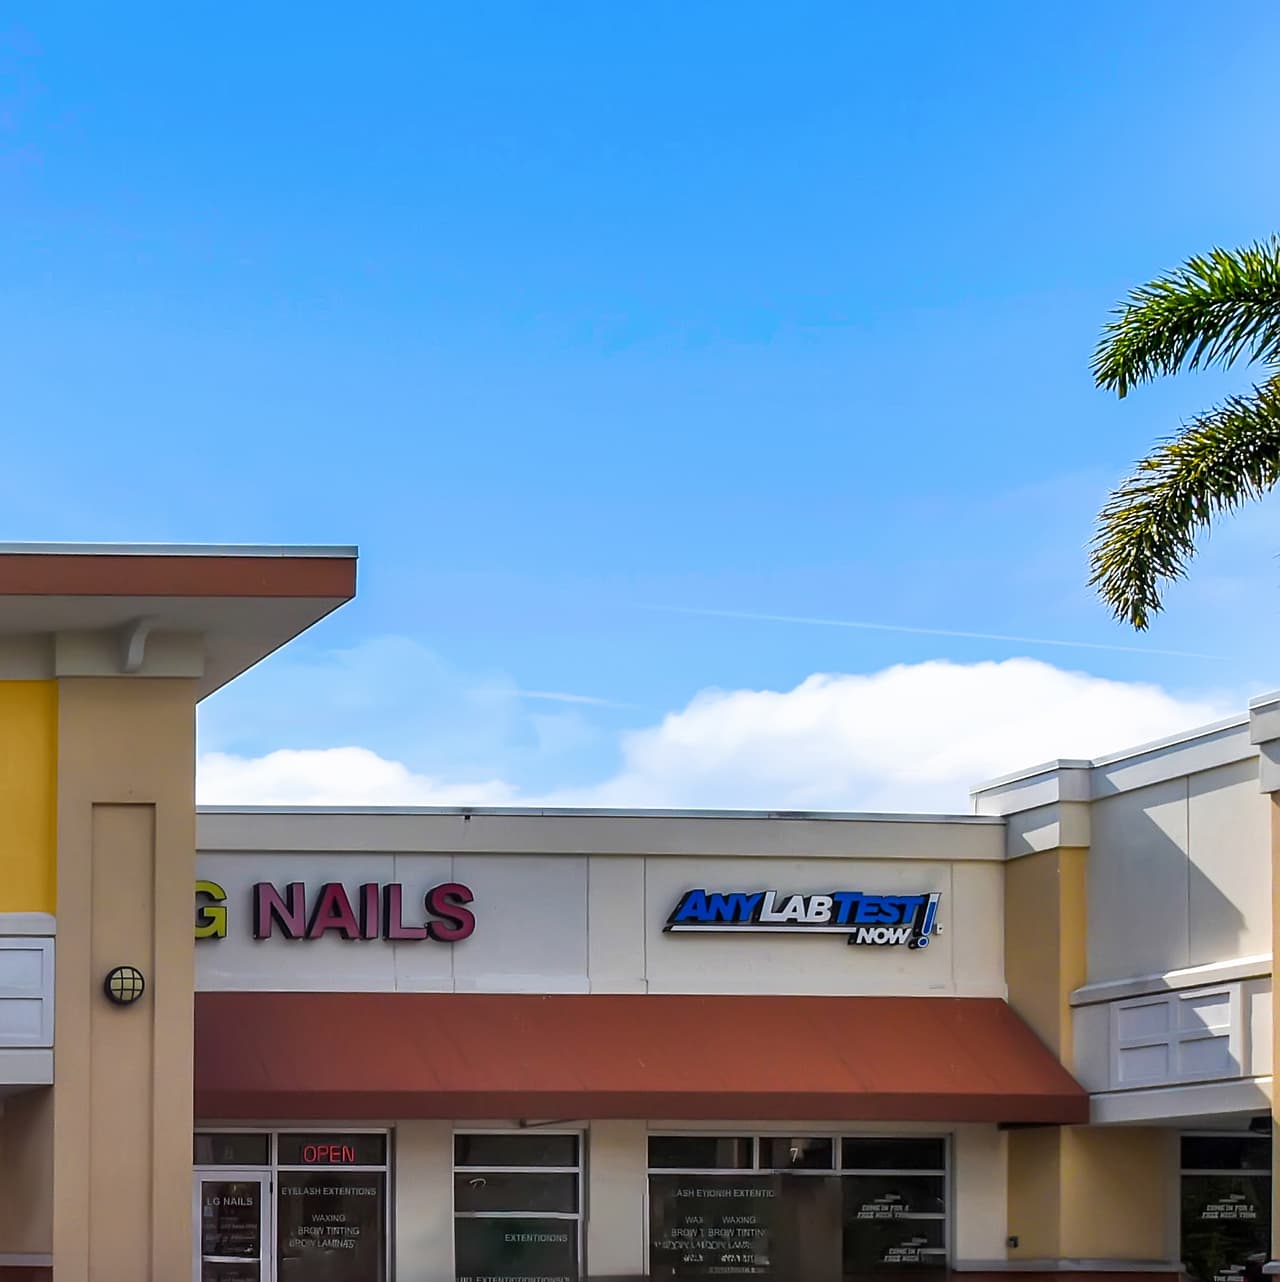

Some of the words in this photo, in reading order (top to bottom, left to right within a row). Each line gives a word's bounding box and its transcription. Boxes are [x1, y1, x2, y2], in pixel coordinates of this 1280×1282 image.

[252, 881, 476, 942] NAILS
[302, 1144, 356, 1164] OPEN
[789, 1147, 799, 1164] 7
[281, 1187, 322, 1196] EYELASH
[323, 1187, 377, 1196] EXTENTIONS
[207, 1197, 221, 1206] LG
[223, 1197, 254, 1206] NAILS
[311, 1214, 347, 1223] WAXING
